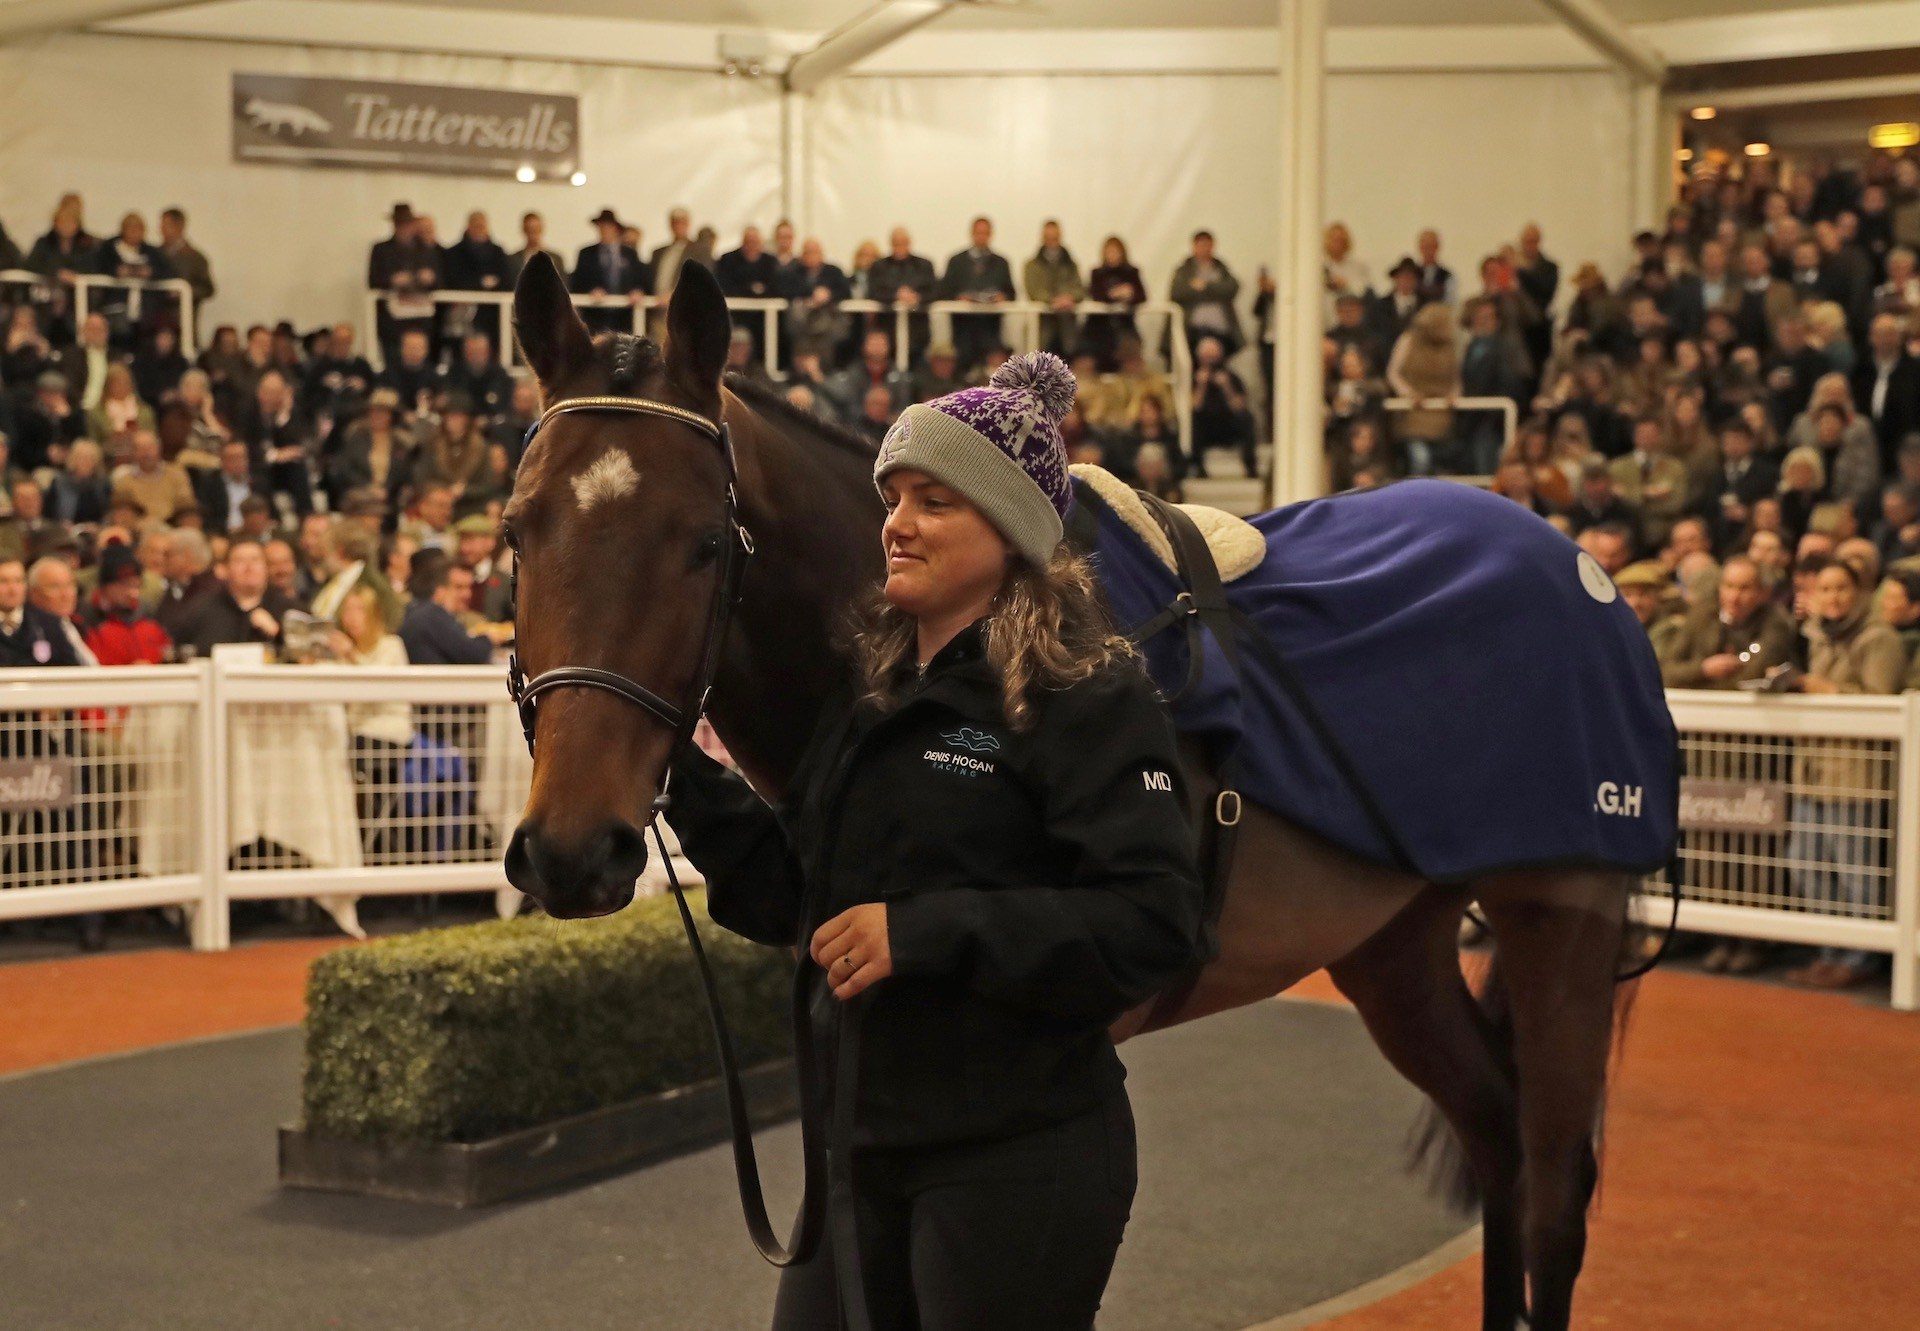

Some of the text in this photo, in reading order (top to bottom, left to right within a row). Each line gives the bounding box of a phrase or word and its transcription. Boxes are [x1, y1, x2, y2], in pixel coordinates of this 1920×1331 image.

[343, 93, 574, 153] Tattersalls
[923, 751, 995, 773] DENIS HOGAN
[932, 762, 977, 777] RACING
[1142, 771, 1172, 792] MD
